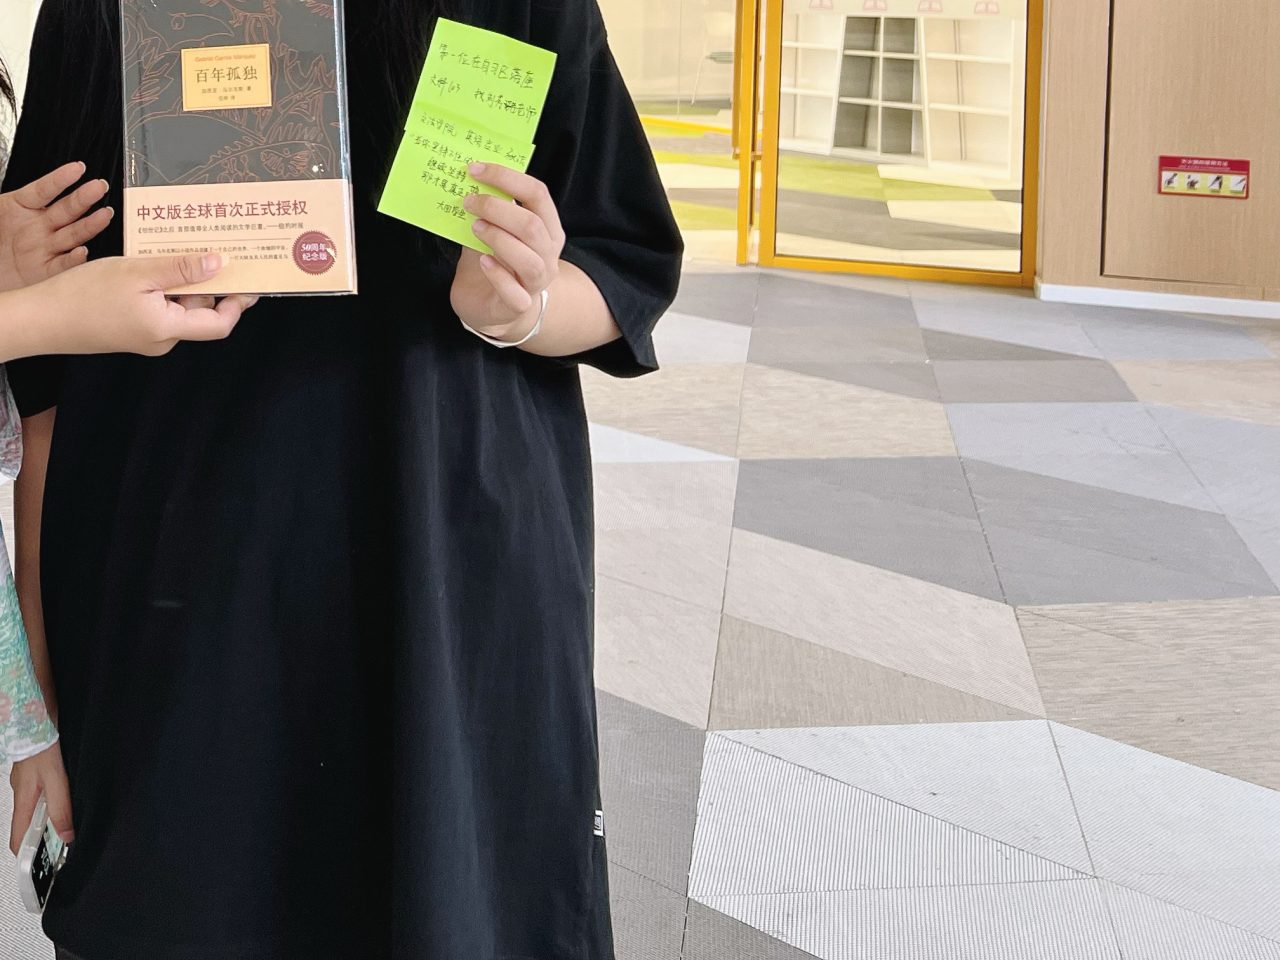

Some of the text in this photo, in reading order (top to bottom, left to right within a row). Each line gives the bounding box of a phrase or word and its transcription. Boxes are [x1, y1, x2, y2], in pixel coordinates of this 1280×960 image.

[194, 65, 258, 83] 百年孤独
[137, 200, 308, 220] 中文版全球首次正式授权
